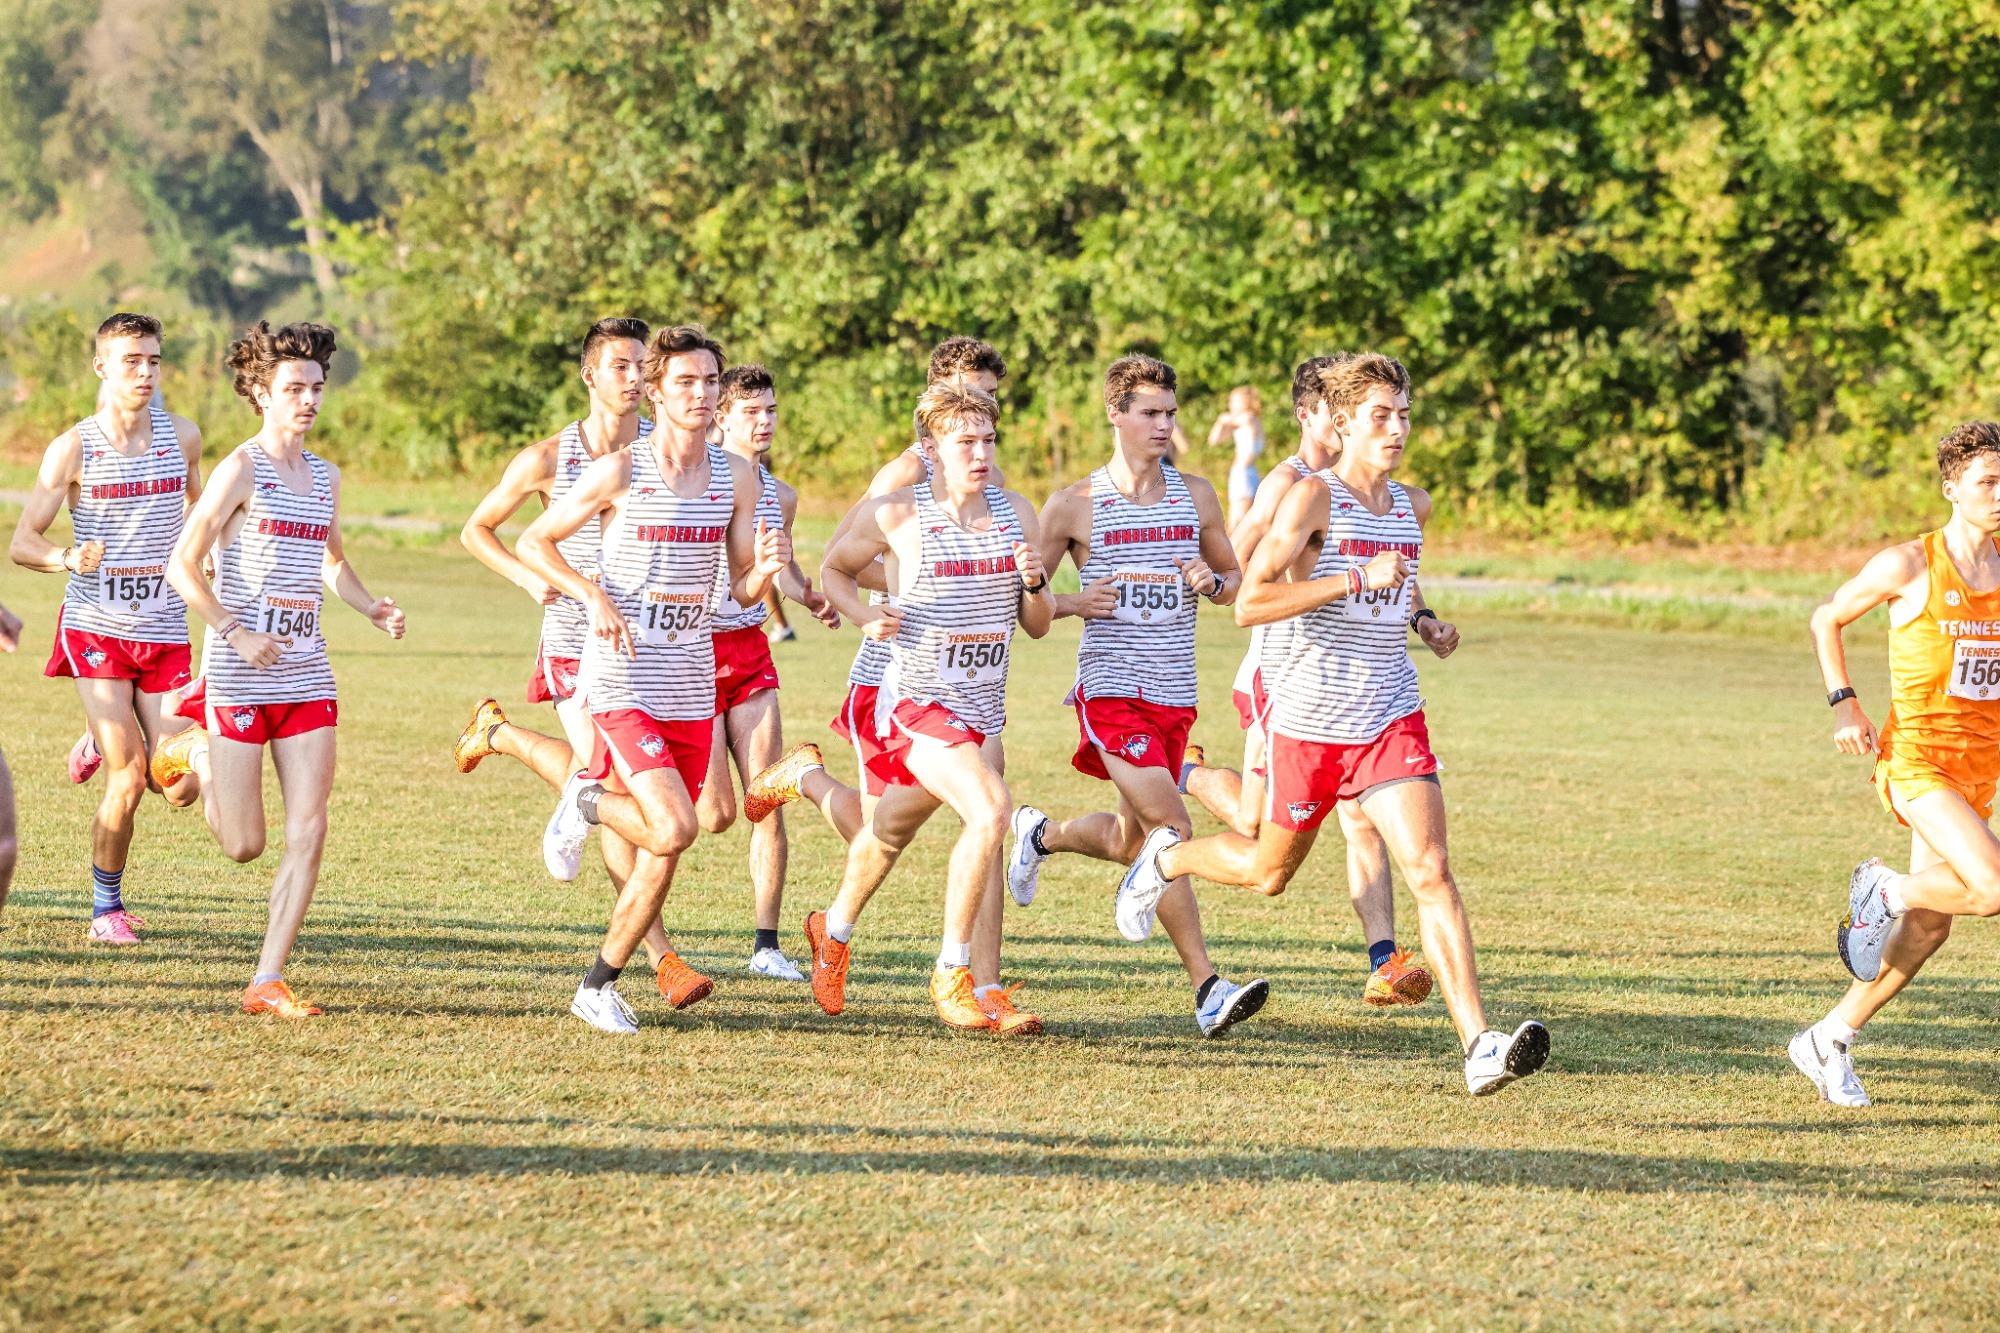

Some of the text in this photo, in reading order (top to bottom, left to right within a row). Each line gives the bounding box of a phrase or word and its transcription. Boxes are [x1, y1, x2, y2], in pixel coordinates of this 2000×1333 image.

[91, 478, 181, 499] CUMBERLANDS
[1104, 526, 1194, 546] CUMBERLANDS
[105, 565, 163, 577] TENNESSEE
[1117, 573, 1177, 584] TENNESSEE
[104, 577, 164, 601] 1557
[649, 591, 704, 603] TENNESSEE
[1117, 583, 1179, 610] 1555
[266, 596, 316, 611] TENNESSEE
[264, 610, 315, 638] 1549
[646, 603, 703, 630] 1552
[948, 631, 1007, 643] TENNESSEE
[1937, 620, 2000, 636] TENNES
[945, 643, 1005, 669] 1550
[1960, 646, 2000, 658] TENNES
[1958, 658, 2000, 686] 156
